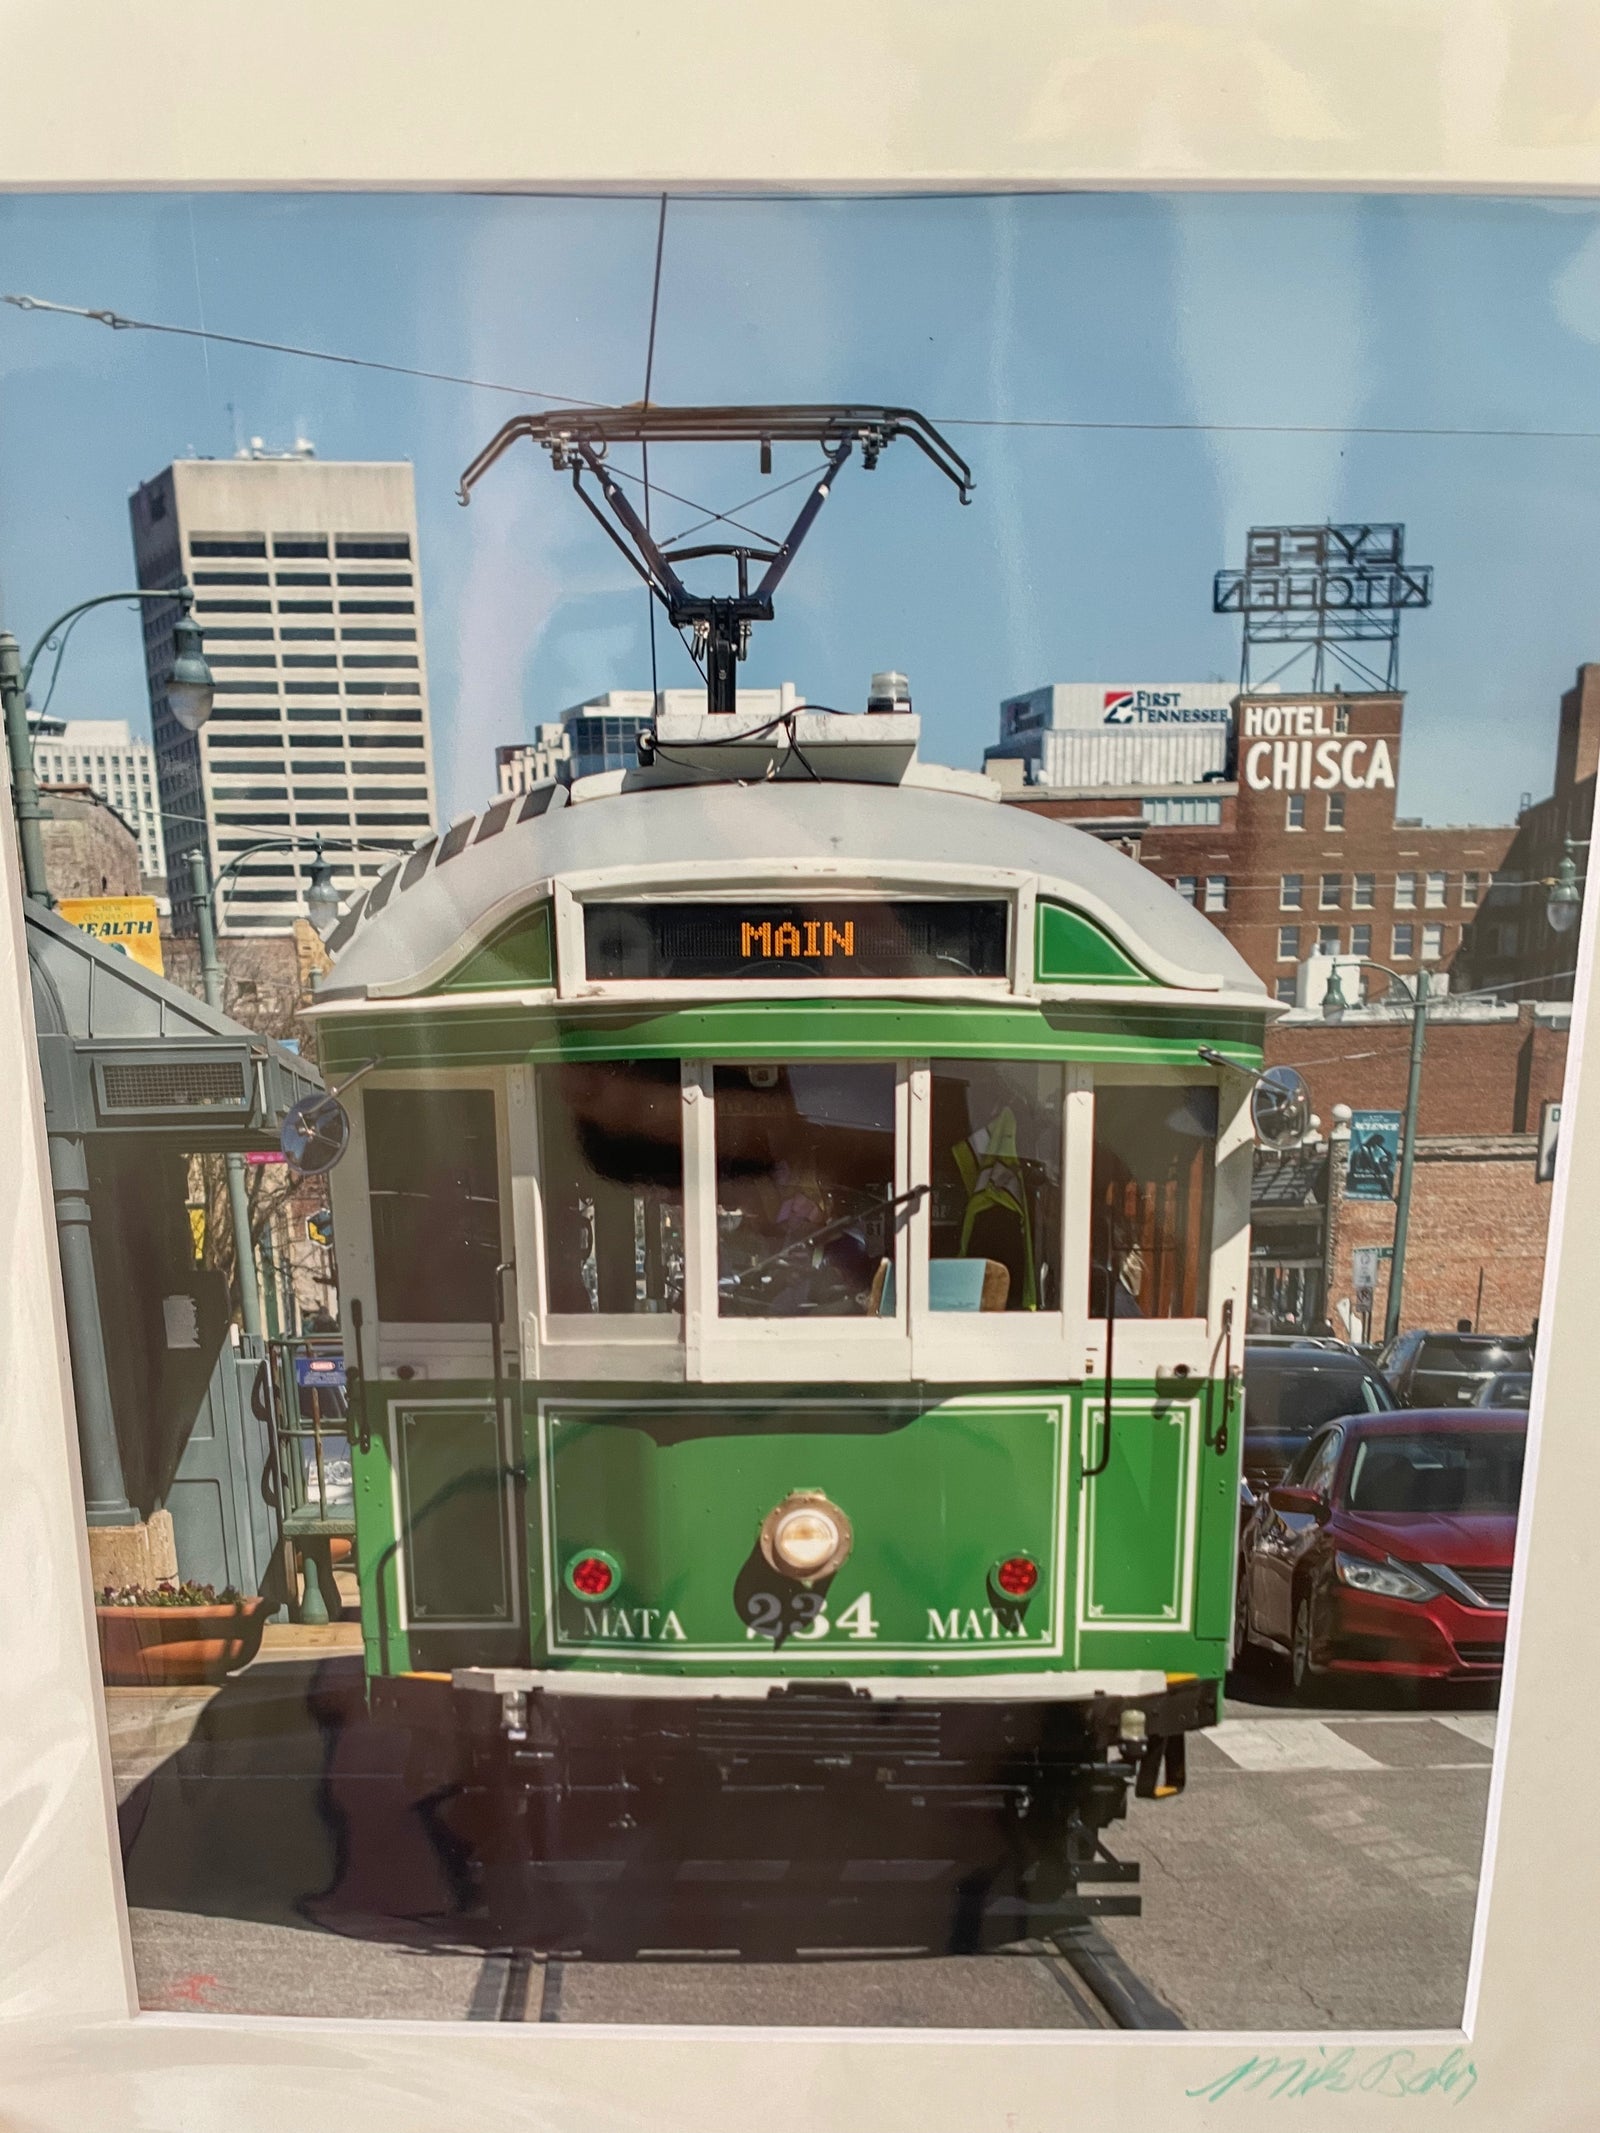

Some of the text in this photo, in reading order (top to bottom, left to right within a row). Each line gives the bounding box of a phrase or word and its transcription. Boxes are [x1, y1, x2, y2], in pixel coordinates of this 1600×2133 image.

[1132, 707, 1228, 723] TENNESSEE
[1136, 691, 1181, 706] FIRST
[1244, 706, 1331, 736] HOTEL
[1246, 740, 1395, 790] CHISCA
[741, 921, 854, 957] MAIN
[583, 1606, 688, 1640] MATA
[746, 1591, 880, 1640] 234
[926, 1607, 1029, 1640] MATA
